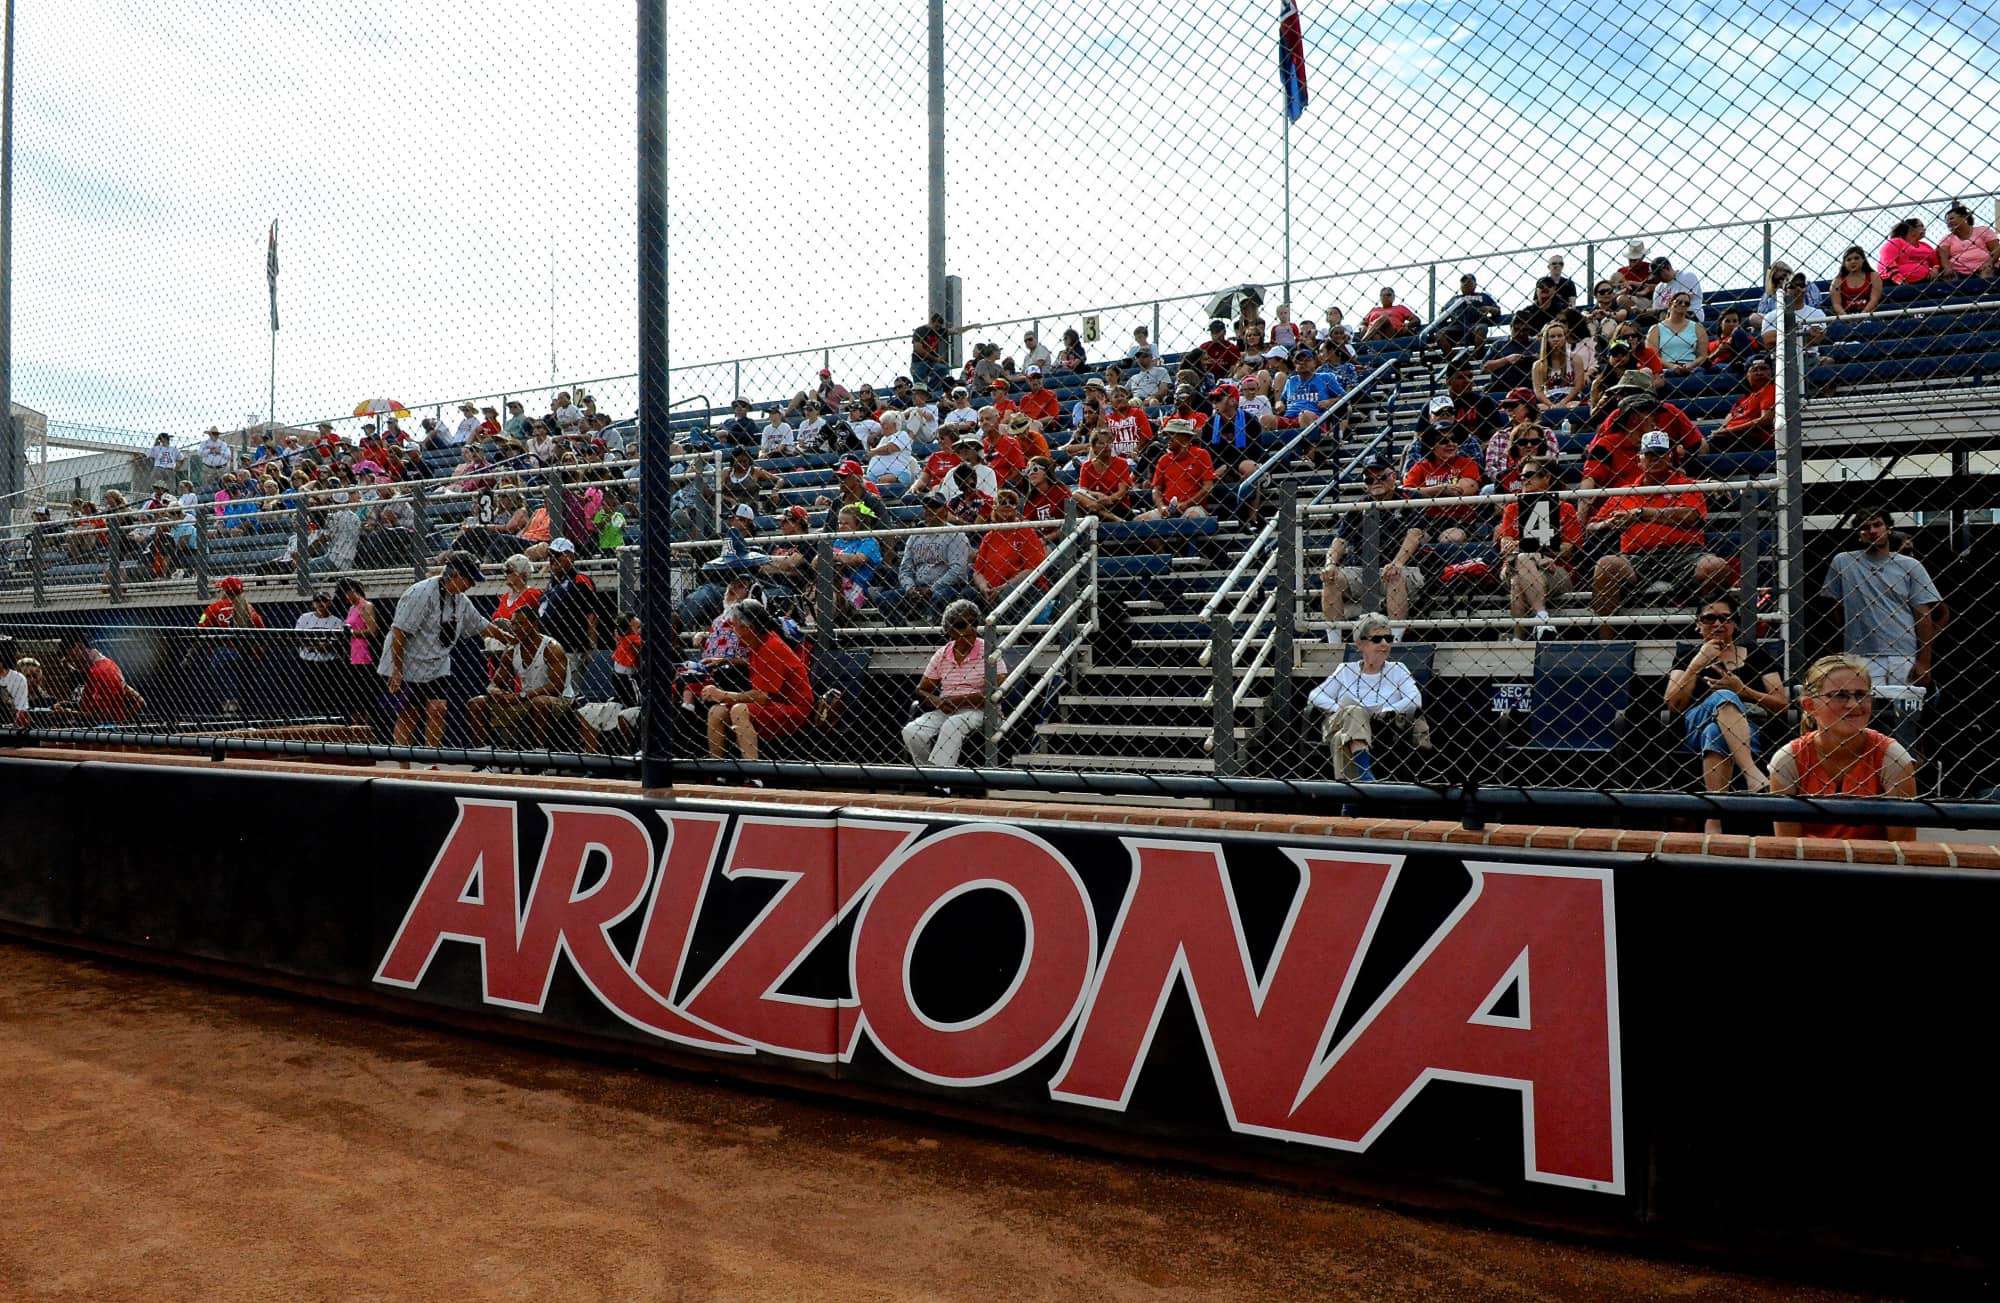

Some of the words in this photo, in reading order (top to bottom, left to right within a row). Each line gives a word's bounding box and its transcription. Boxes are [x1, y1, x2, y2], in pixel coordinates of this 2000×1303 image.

[1087, 317, 1097, 341] 3
[480, 495, 491, 522] 3
[1523, 501, 1554, 546] 4
[25, 539, 33, 560] 2
[1500, 686, 1522, 698] SEC
[372, 797, 1626, 1196] ARIZONA
